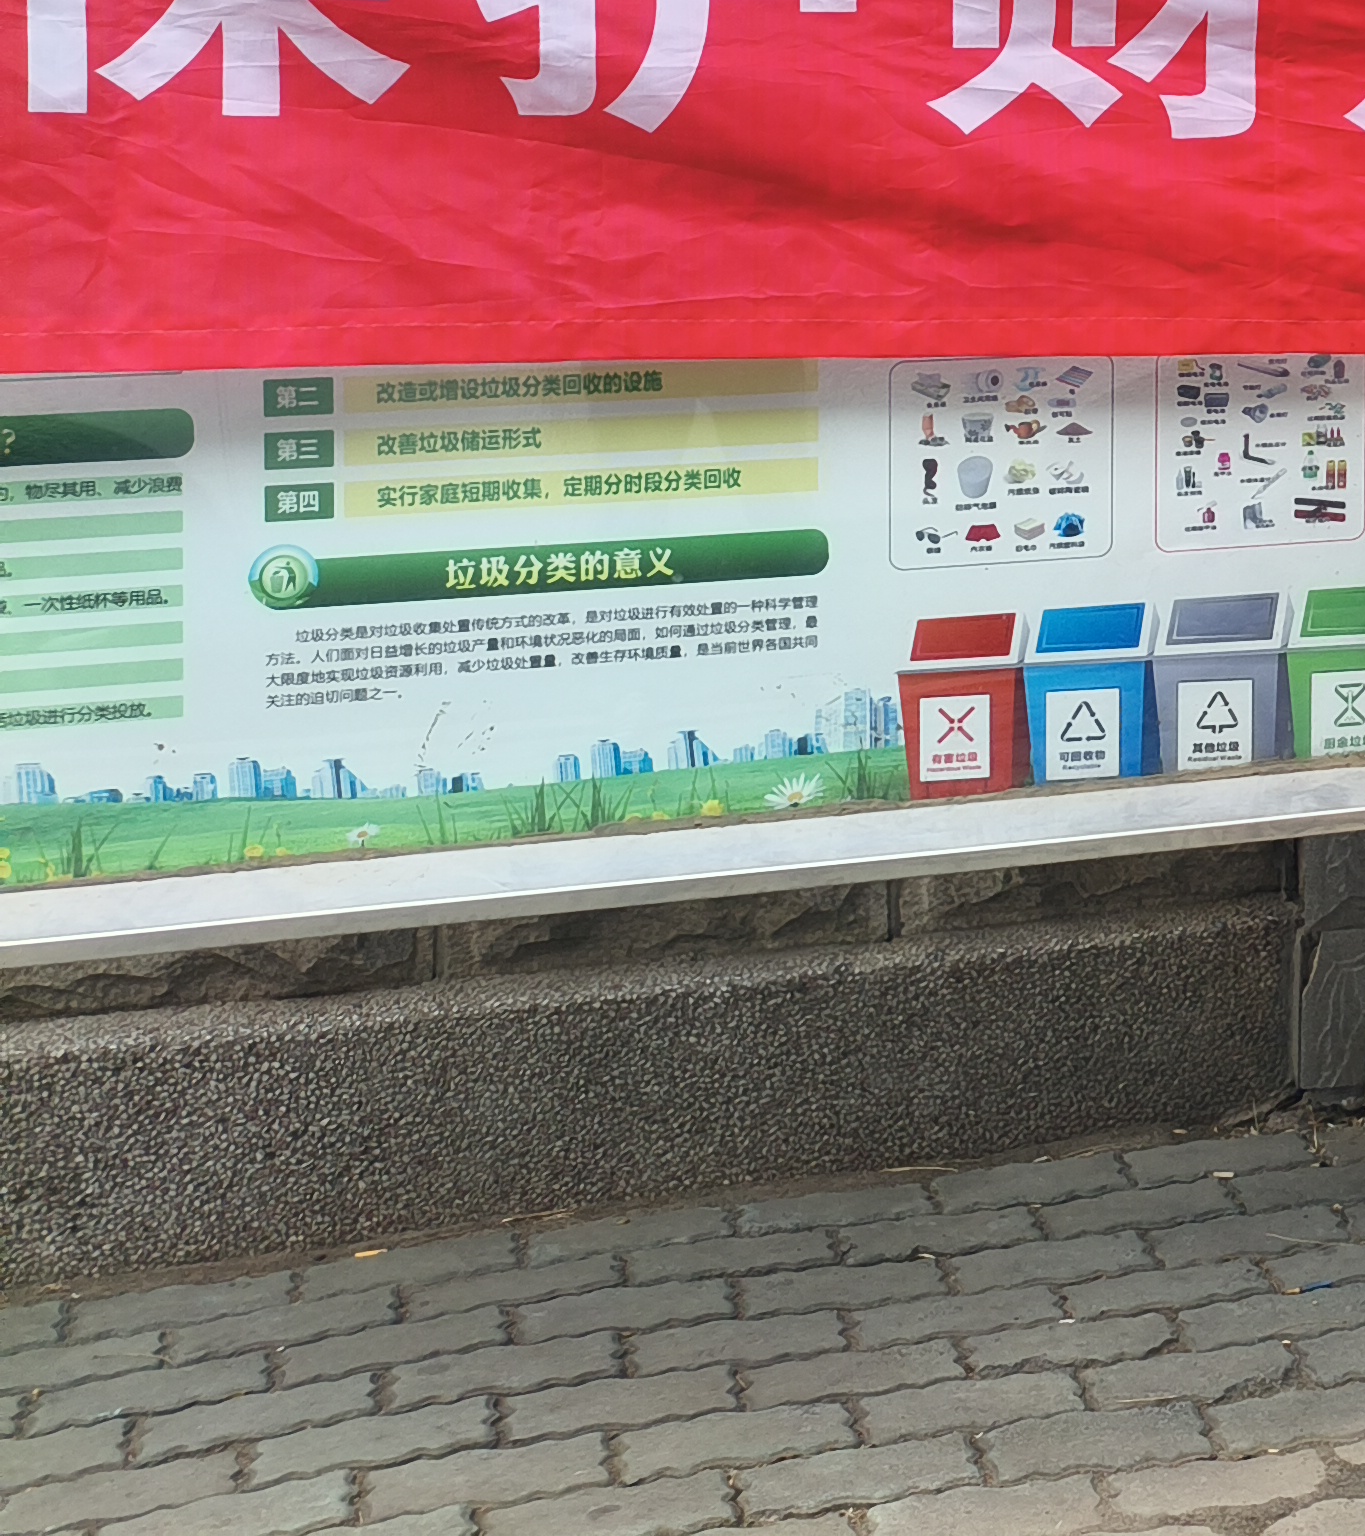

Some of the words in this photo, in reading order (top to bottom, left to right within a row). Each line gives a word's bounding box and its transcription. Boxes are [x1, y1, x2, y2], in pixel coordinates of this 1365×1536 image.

[276, 384, 318, 408] 第二
[376, 370, 663, 404] 改造或增设垃圾分类回收的设施
[276, 438, 318, 462] 第三
[377, 428, 541, 457] 改善垃圾储运形式
[276, 490, 319, 514] 第四
[446, 547, 674, 590] 垃圾分类的意义
[1192, 741, 1239, 754] 其他垃圾
